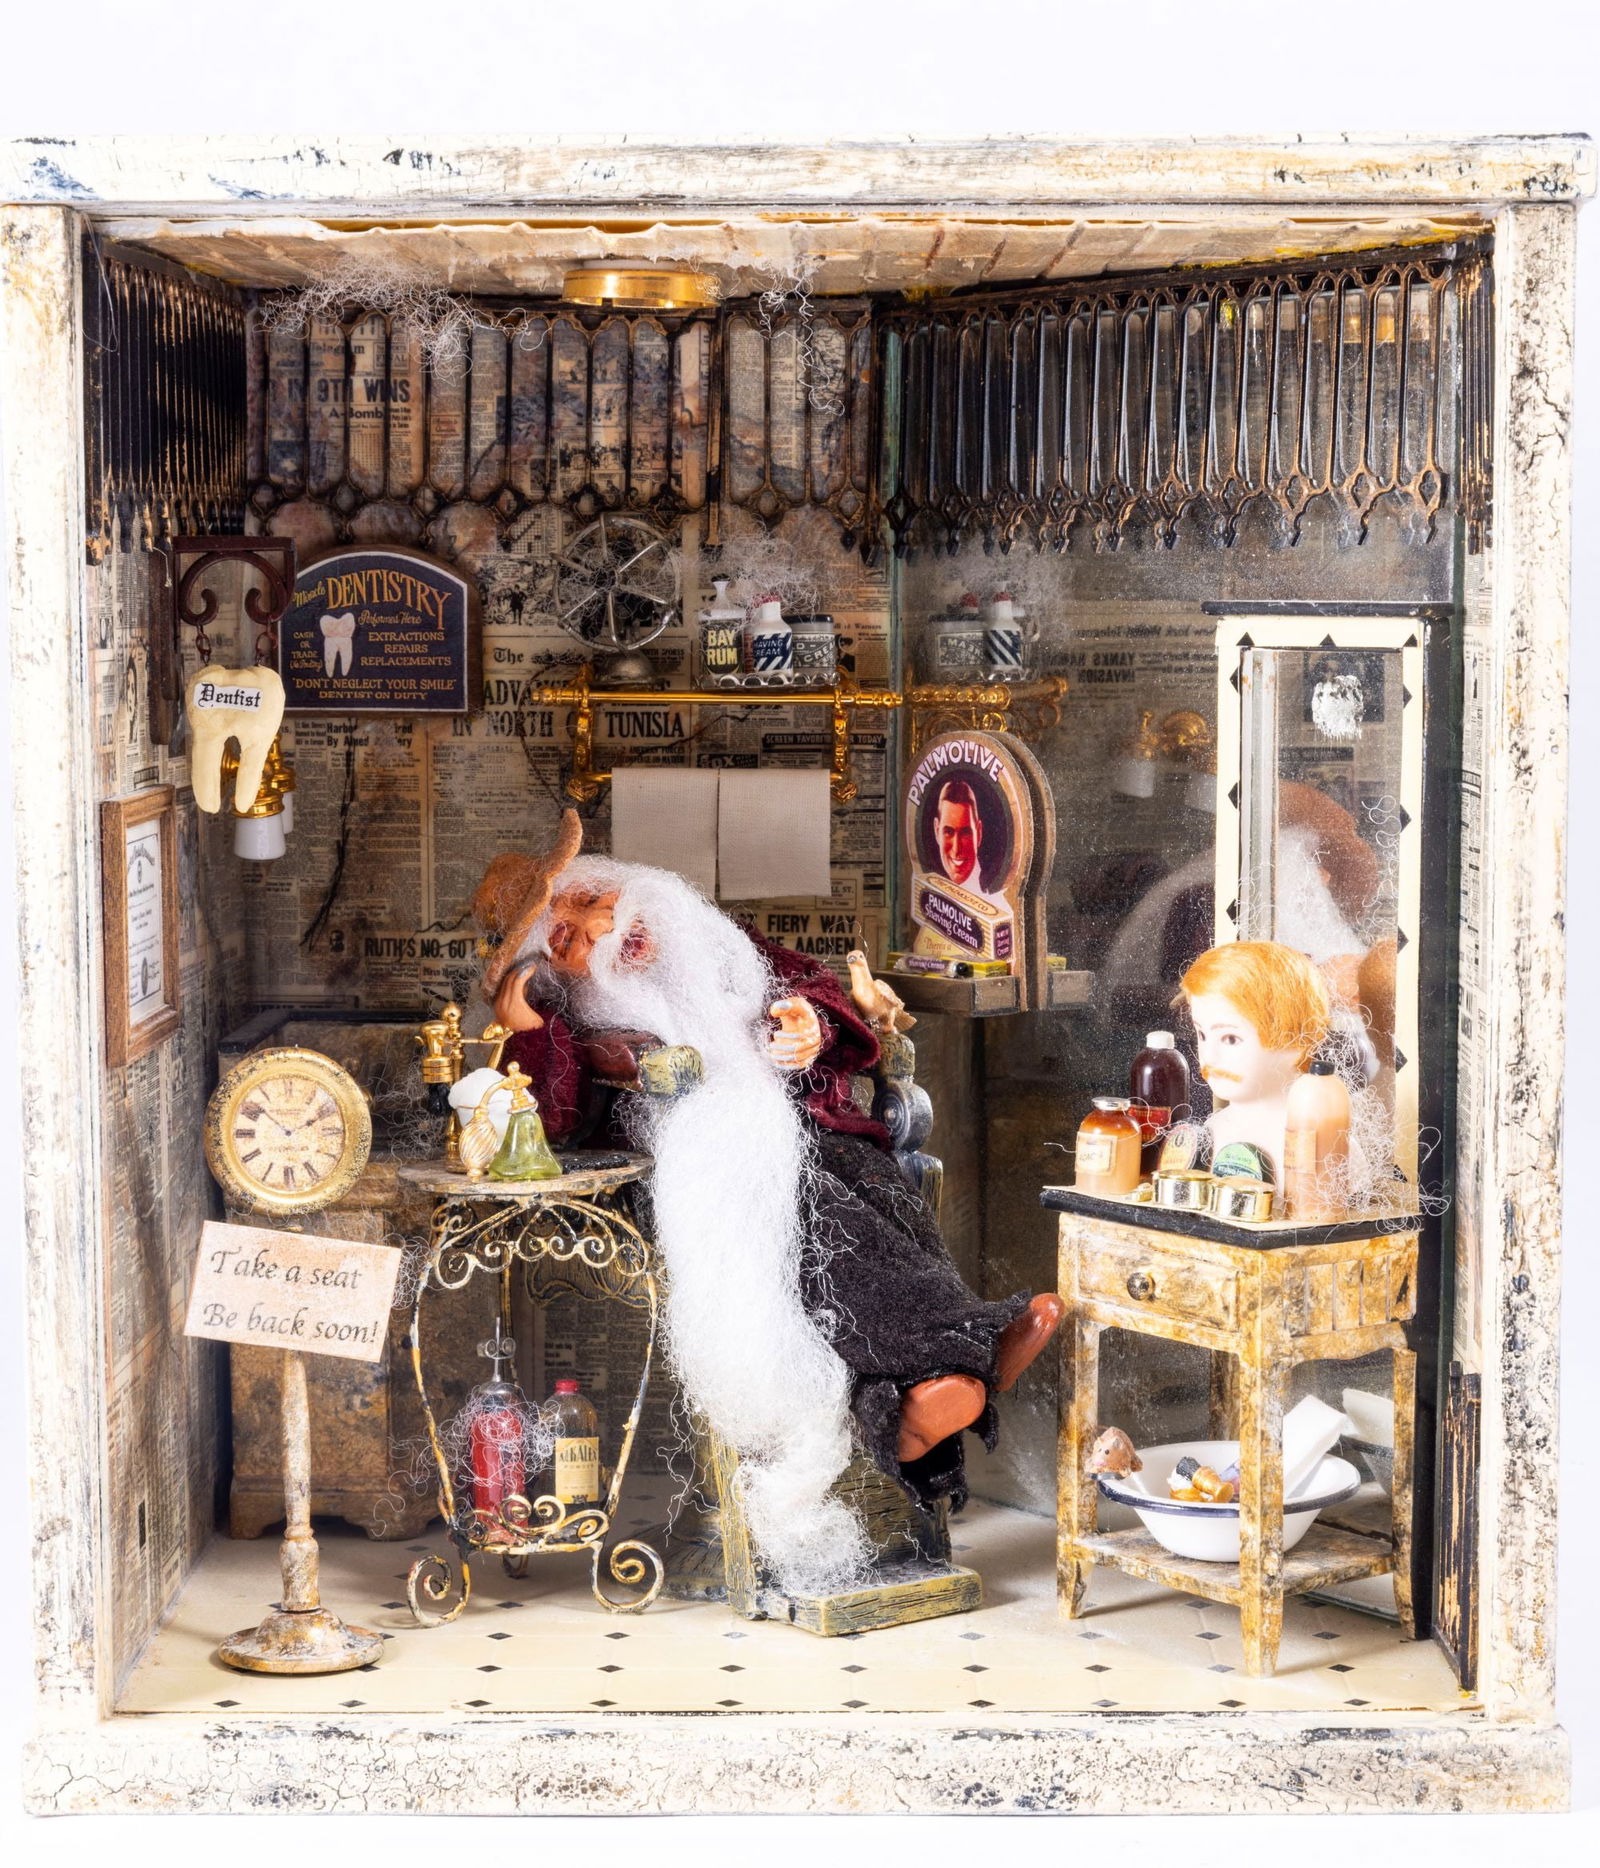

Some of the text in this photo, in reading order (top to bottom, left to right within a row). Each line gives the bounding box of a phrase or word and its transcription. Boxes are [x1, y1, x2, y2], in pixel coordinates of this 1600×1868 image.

[326, 569, 452, 630] DENTISTRY
[293, 631, 314, 640] CASH
[368, 631, 445, 642] EXTRACTIONS
[707, 629, 736, 647] BAY
[291, 651, 319, 659] TRADE
[384, 644, 428, 654] REPAIRS
[493, 647, 525, 664] The
[707, 647, 738, 666] RUM
[360, 656, 451, 667] REPLACEMENTS
[333, 678, 383, 690] NEGLECT
[385, 678, 417, 690] YOUR
[198, 682, 261, 708] Dentist
[319, 690, 428, 700] DENTIST ON DUTY
[486, 710, 554, 737] NORTH
[605, 711, 685, 738] TUNISIA
[858, 734, 883, 745] TODAY
[908, 740, 1005, 807] PALMOLIVE
[928, 893, 973, 932] PALMOLIVE
[767, 914, 856, 933] FIERY WAY
[925, 903, 978, 949] Shaving Cream
[364, 937, 466, 959] RUTH'S NO. 60
[795, 936, 856, 955] AACHEN
[210, 1246, 362, 1290] Take a seat
[203, 1301, 381, 1345] Be back soon!
